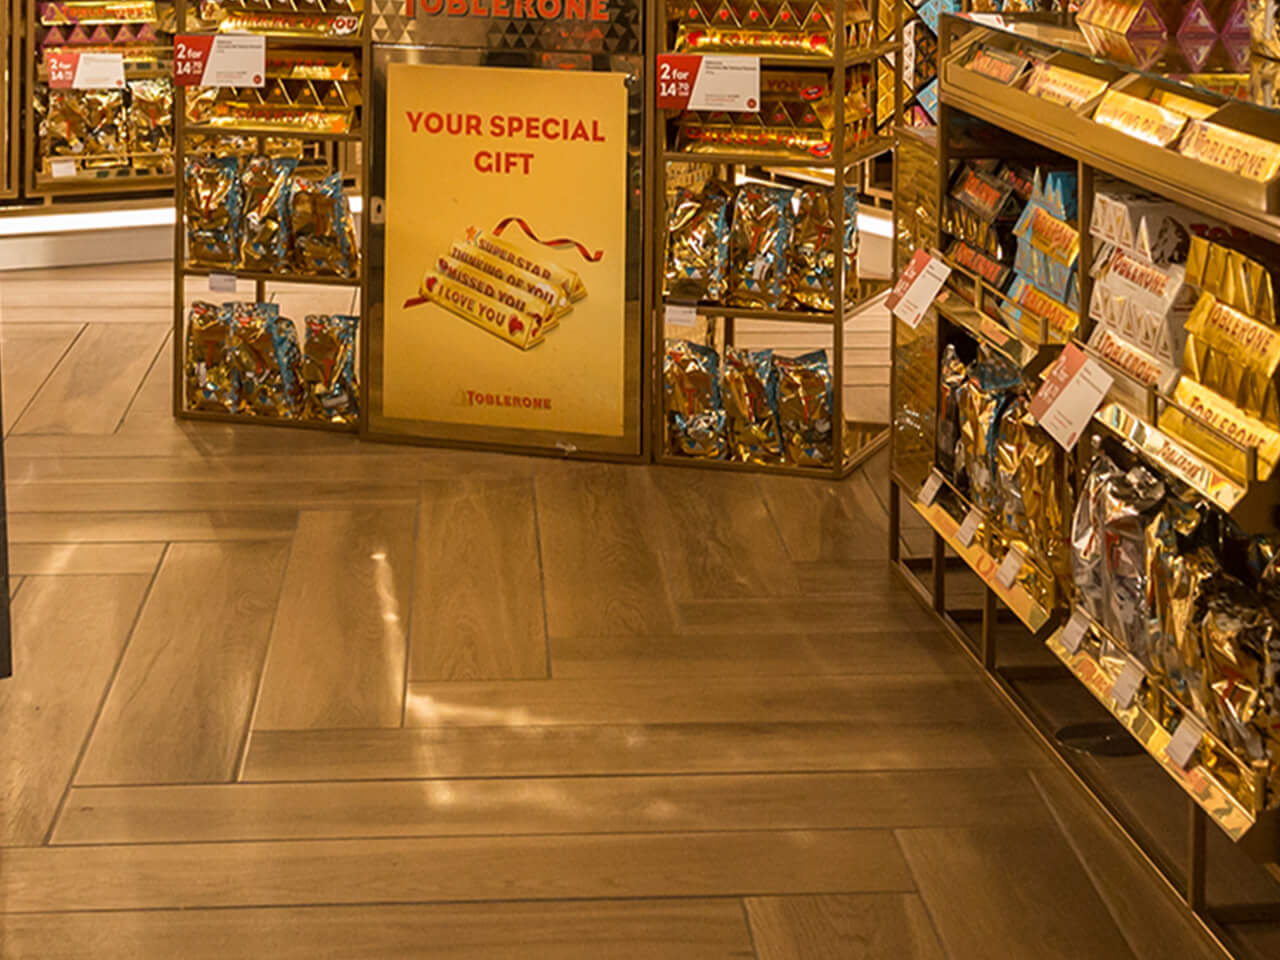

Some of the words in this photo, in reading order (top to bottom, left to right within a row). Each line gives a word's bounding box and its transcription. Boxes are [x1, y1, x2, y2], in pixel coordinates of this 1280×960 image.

[327, 18, 356, 30] YOU
[177, 43, 186, 59] 2
[187, 48, 202, 59] for
[660, 63, 671, 80] 2
[672, 68, 690, 80] for
[406, 111, 482, 137] YOUR
[490, 115, 606, 142] SPECIAL
[474, 150, 535, 175] GIFT
[478, 238, 552, 281] SUPERSTAR
[447, 266, 495, 298] MISSED
[498, 291, 527, 312] YOU
[451, 247, 504, 279] THINKING
[506, 274, 525, 290] OF
[527, 282, 554, 306] YOU
[438, 285, 444, 297] I
[445, 287, 475, 311] LOVE
[478, 300, 506, 327] YOU
[466, 390, 552, 410] TOBLERONE
